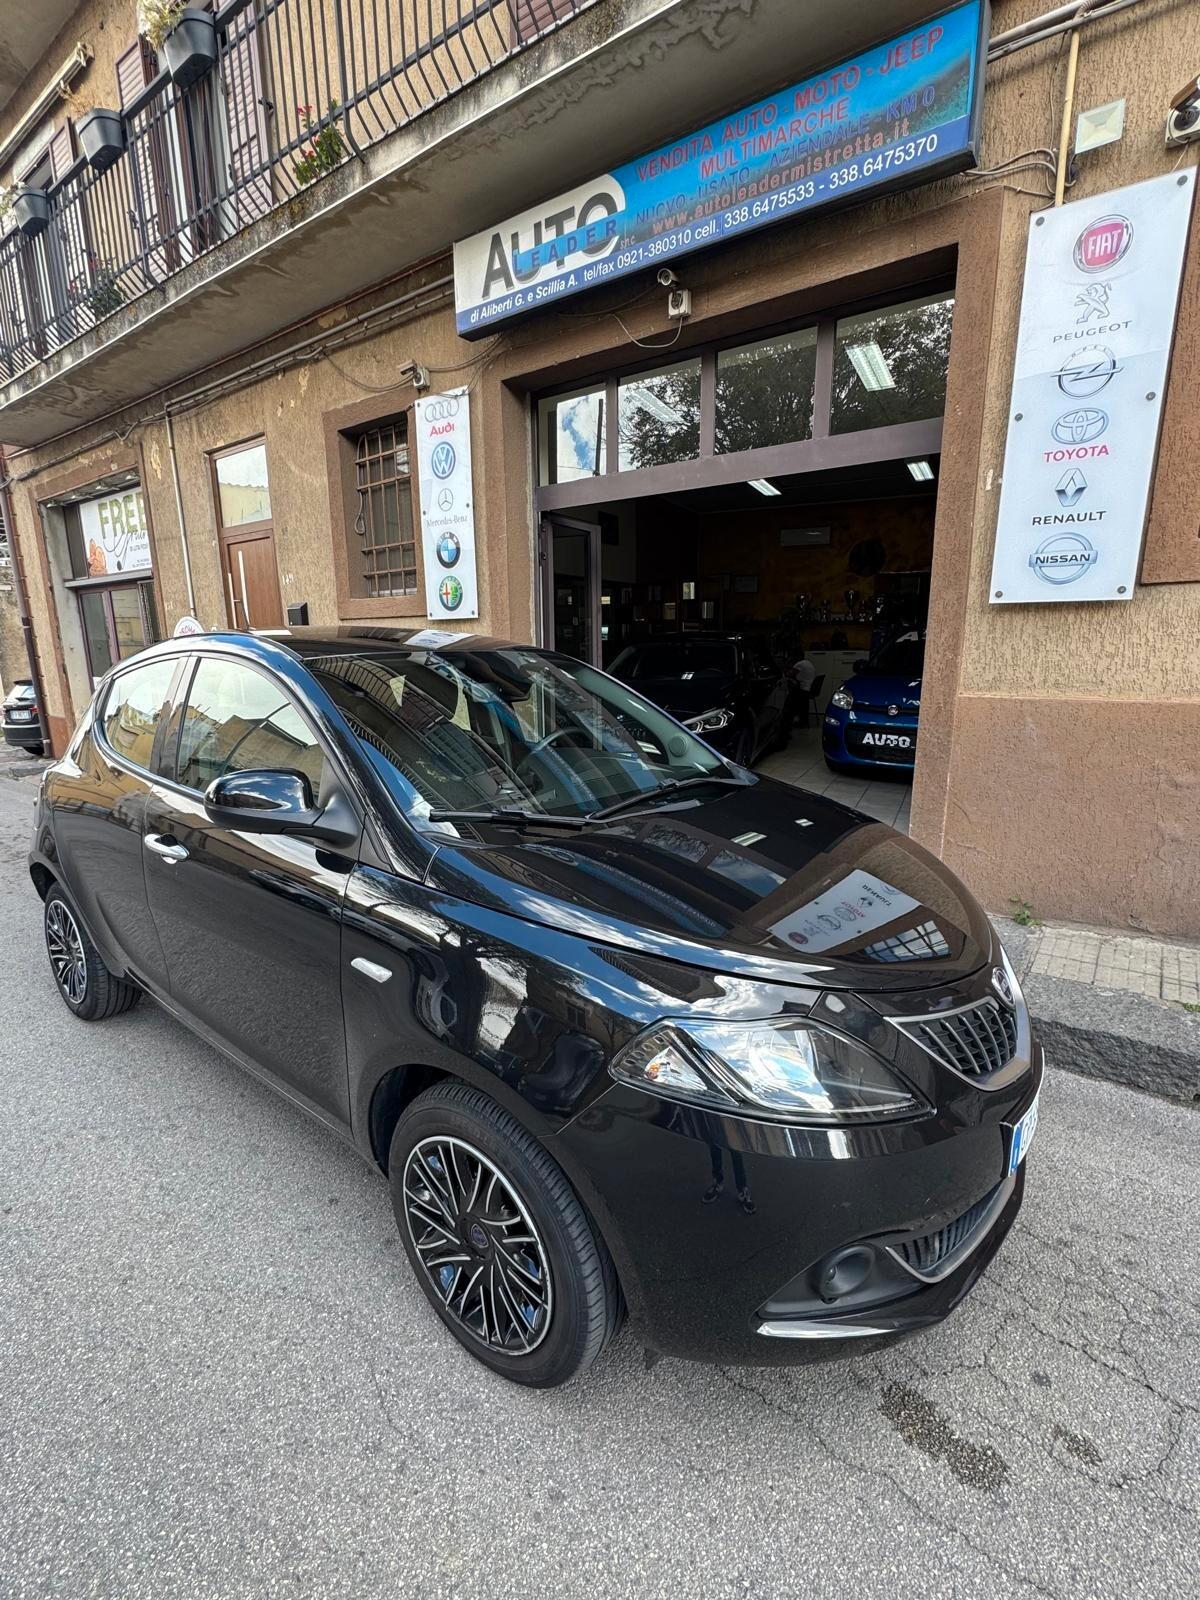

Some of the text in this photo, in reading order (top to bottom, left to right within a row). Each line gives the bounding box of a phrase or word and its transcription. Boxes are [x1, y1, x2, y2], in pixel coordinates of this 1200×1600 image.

[637, 133, 713, 182] VENDITA
[722, 102, 778, 145] AUTO
[794, 65, 861, 112] MOTO
[879, 25, 944, 75] JEEP
[700, 96, 850, 181] MULTIMARCHE
[636, 193, 687, 226] NUOVO
[697, 166, 751, 199] USATO
[768, 113, 871, 170] AZIENDALE
[652, 117, 910, 235] www.autoleadermistretta.it
[470, 309, 480, 323] di
[480, 297, 513, 319] Aliberti
[514, 293, 525, 308] G.
[527, 292, 534, 302] e
[535, 279, 565, 299] Scillia
[567, 274, 578, 288] A.
[583, 261, 615, 283] tel/fax
[616, 229, 692, 269] 0921-380310
[694, 219, 719, 240] cell.
[723, 181, 815, 229] 338.6475533
[829, 133, 938, 190] 338.6475370
[481, 192, 618, 301] AUTO
[513, 219, 618, 271] LEADER
[1086, 229, 1121, 260] FIAT
[1052, 320, 1133, 343] PEUGEOT
[429, 422, 455, 437] Audi
[1043, 444, 1109, 463] TOYOTA
[426, 514, 468, 528] Mercedes-Benz
[1031, 510, 1107, 526] RENAULT
[1034, 552, 1091, 565] NISSAN
[862, 732, 911, 748] AUTO
